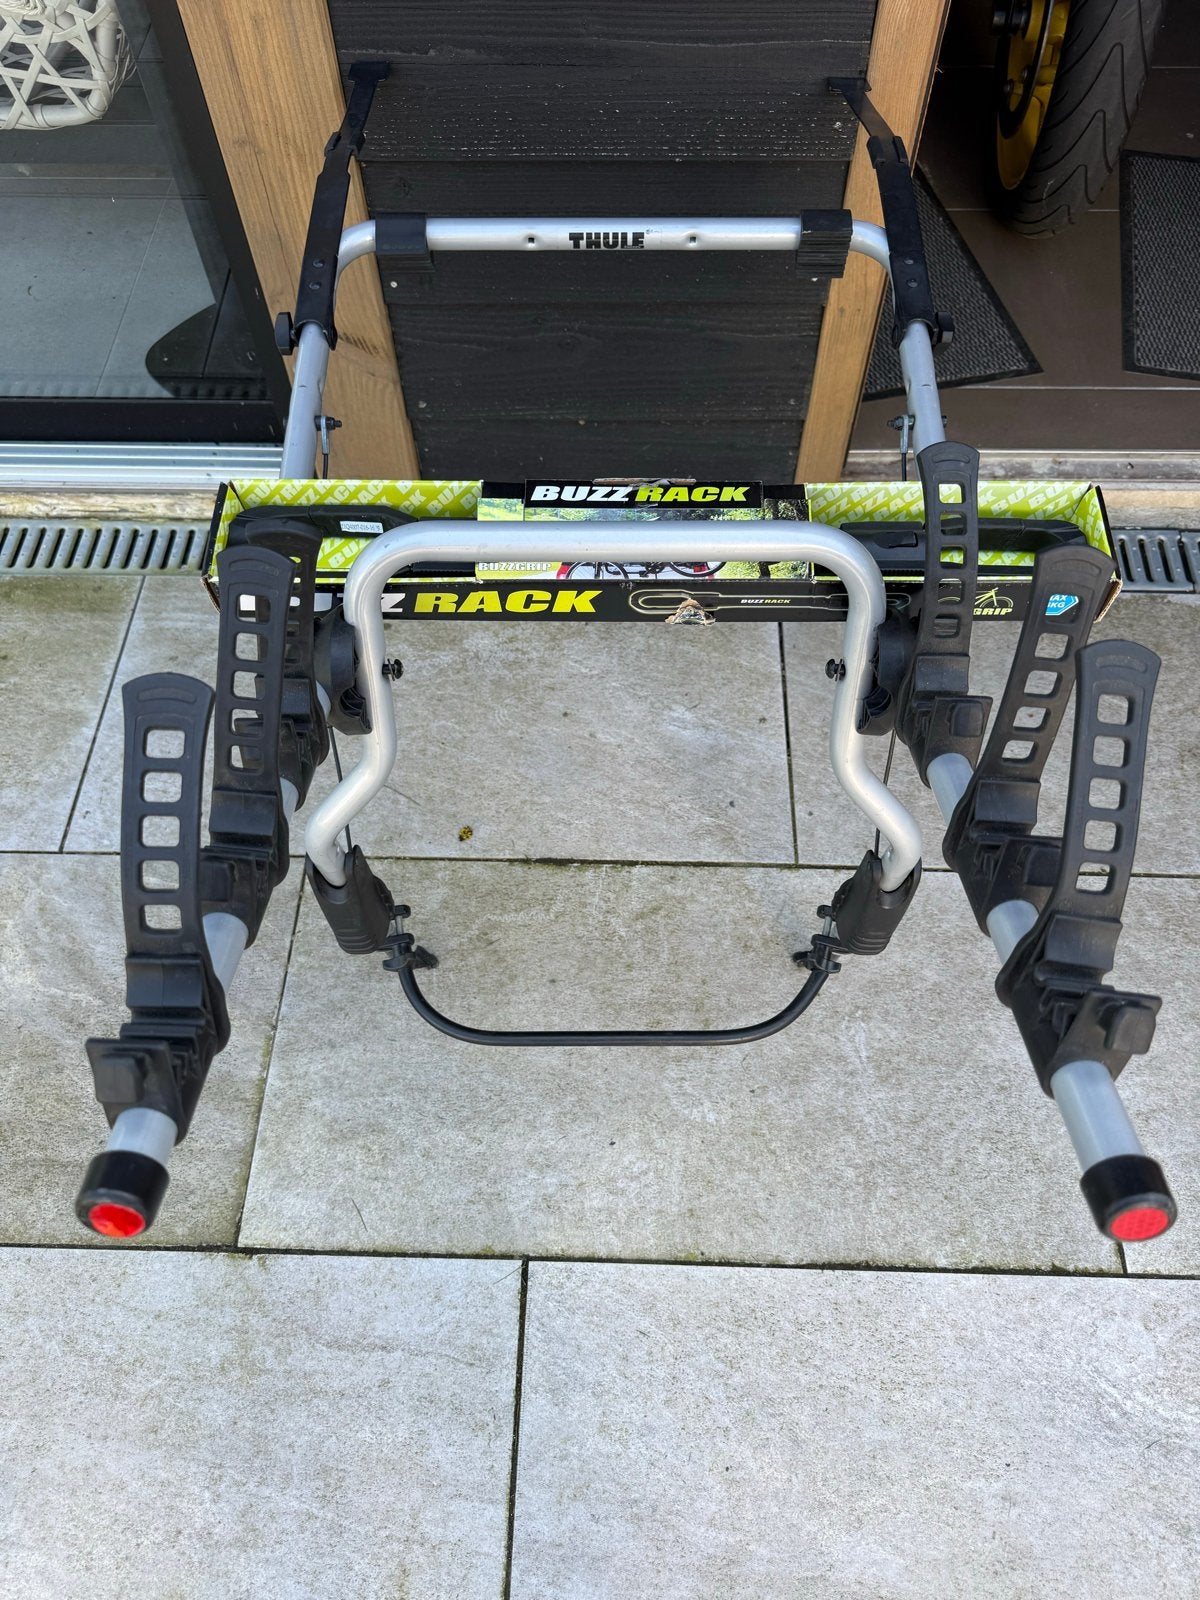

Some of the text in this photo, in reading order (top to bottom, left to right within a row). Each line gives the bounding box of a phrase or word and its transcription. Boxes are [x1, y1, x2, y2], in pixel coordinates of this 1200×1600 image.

[568, 232, 645, 249] THULE
[478, 562, 551, 571] BUZZGRIP
[413, 590, 603, 613] RACK
[972, 608, 1013, 616] GRIP
